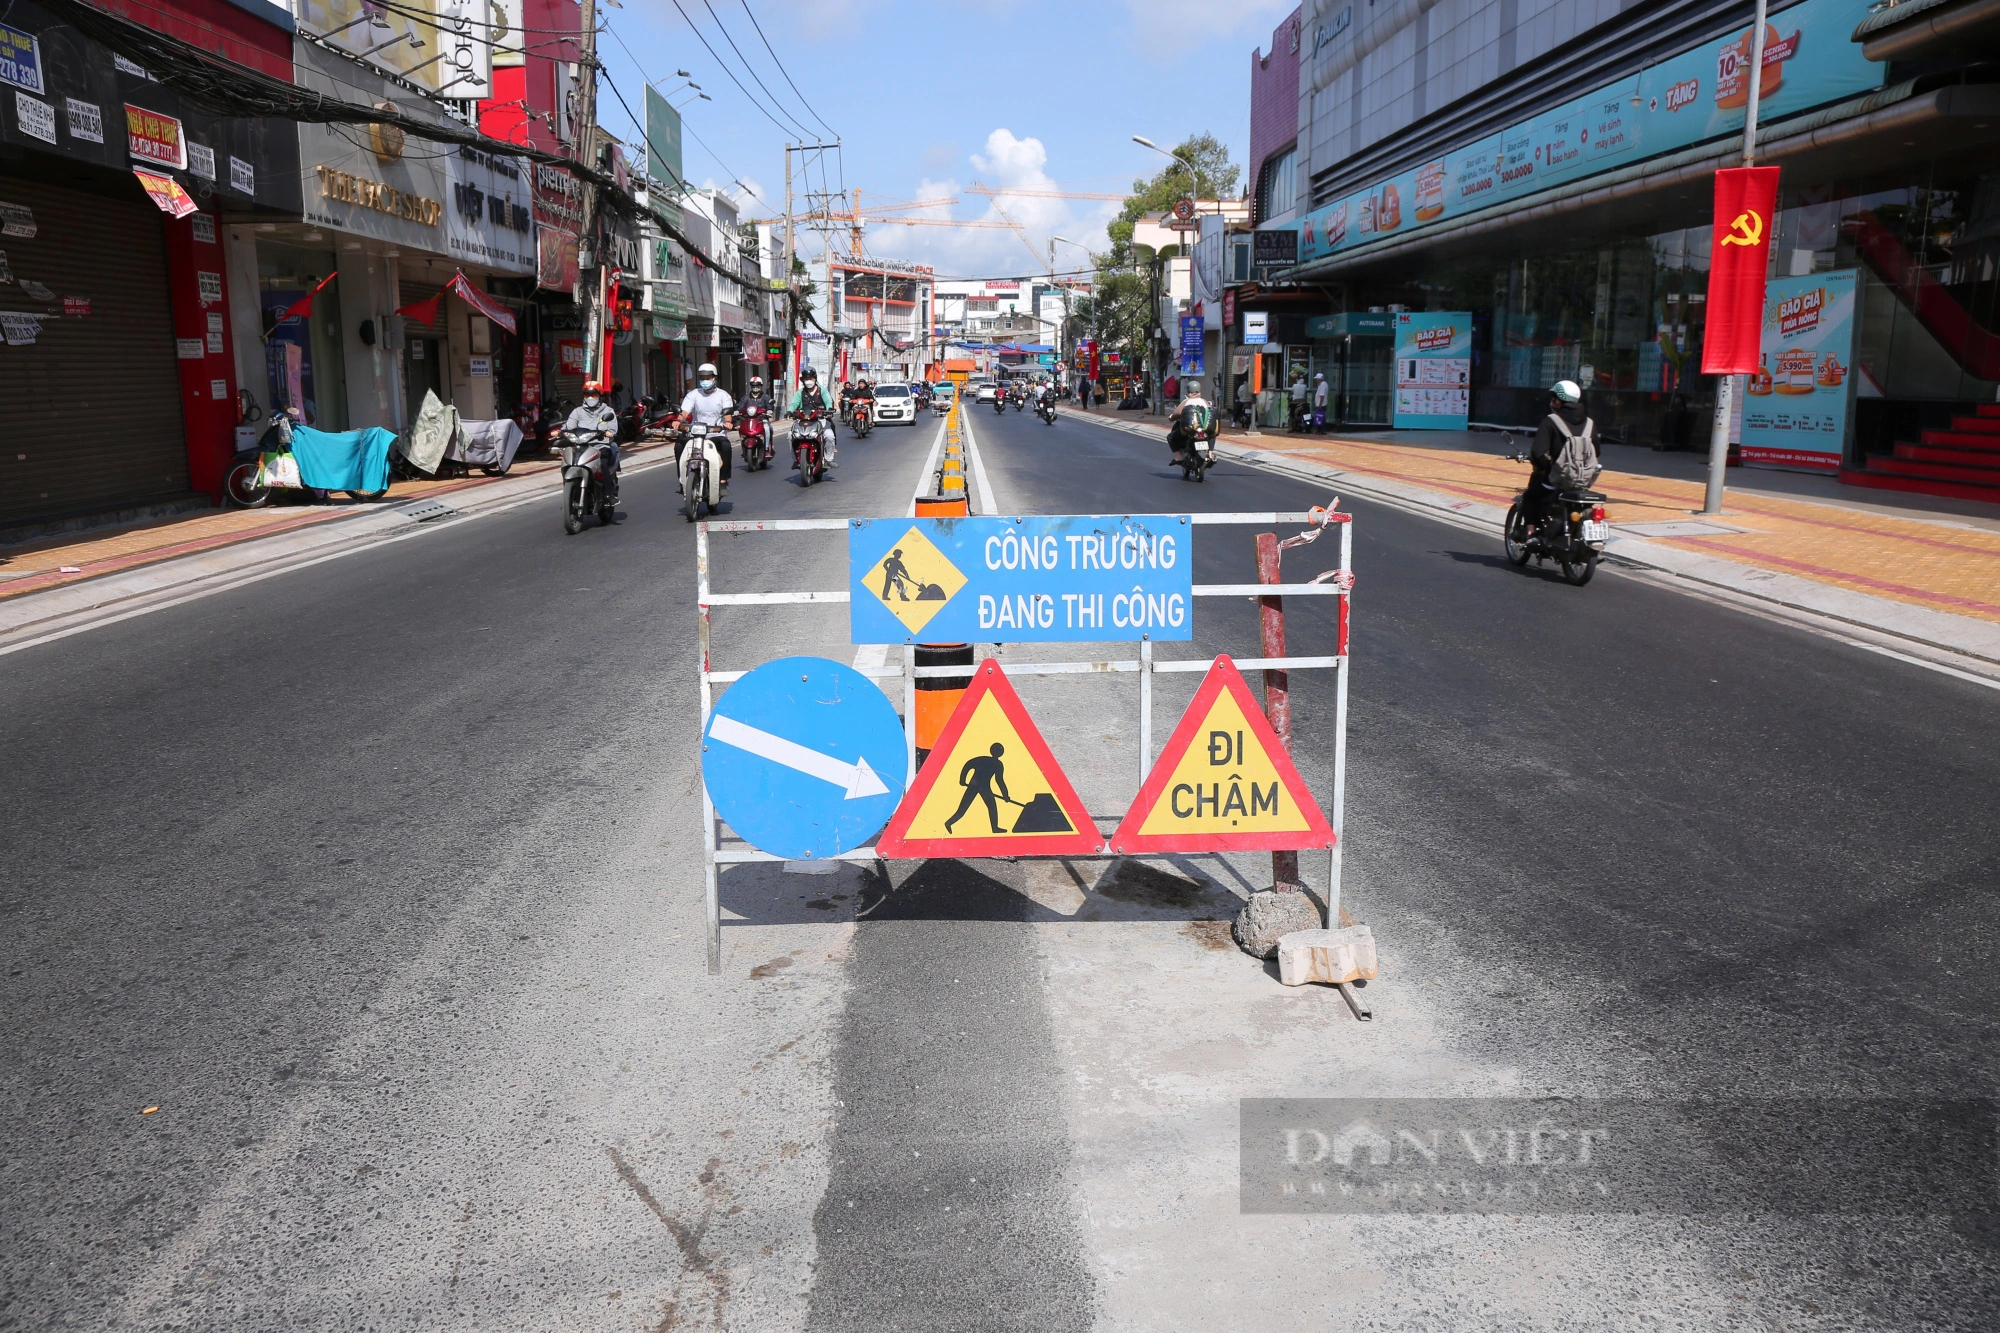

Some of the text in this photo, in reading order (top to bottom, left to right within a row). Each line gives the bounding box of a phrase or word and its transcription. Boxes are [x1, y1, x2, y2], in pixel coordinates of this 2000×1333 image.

[1319, 6, 1351, 48] DAIKIN
[11, 32, 32, 53] THUÊ
[1763, 43, 1788, 57] SENKO
[1768, 49, 1792, 64] 300.000Đ
[20, 64, 38, 88] 339
[1726, 78, 1736, 89] LỌC
[1666, 80, 1697, 110] TẶNG
[1604, 102, 1619, 116] Tặng
[127, 110, 143, 135] NHÀ
[144, 117, 160, 140] CHO
[1555, 122, 1568, 136] Tặng
[1607, 118, 1621, 130] sinh
[1595, 132, 1624, 152] máy lạnh
[1546, 143, 1552, 166] 1
[1501, 162, 1533, 184] 300.000Đ
[317, 165, 442, 227] THE FACE SHOP
[1461, 177, 1493, 197] 1.200.000Đ
[454, 181, 485, 225] VIỆT
[487, 190, 530, 235] THẮNG
[1256, 232, 1296, 247] GYM
[1781, 288, 1821, 319] BÃO GIÁ
[1359, 319, 1385, 327] AUTOBANK
[1399, 315, 1411, 323] NK
[1783, 311, 1818, 331] MÙA NÓNG
[1417, 326, 1452, 342] BÃO GIÁ
[985, 524, 1176, 571] CÔNG TRƯỜNG
[978, 585, 1185, 629] ĐANG THI CÔNG
[1208, 730, 1243, 766] ĐI
[1171, 774, 1279, 826] CHẬM
